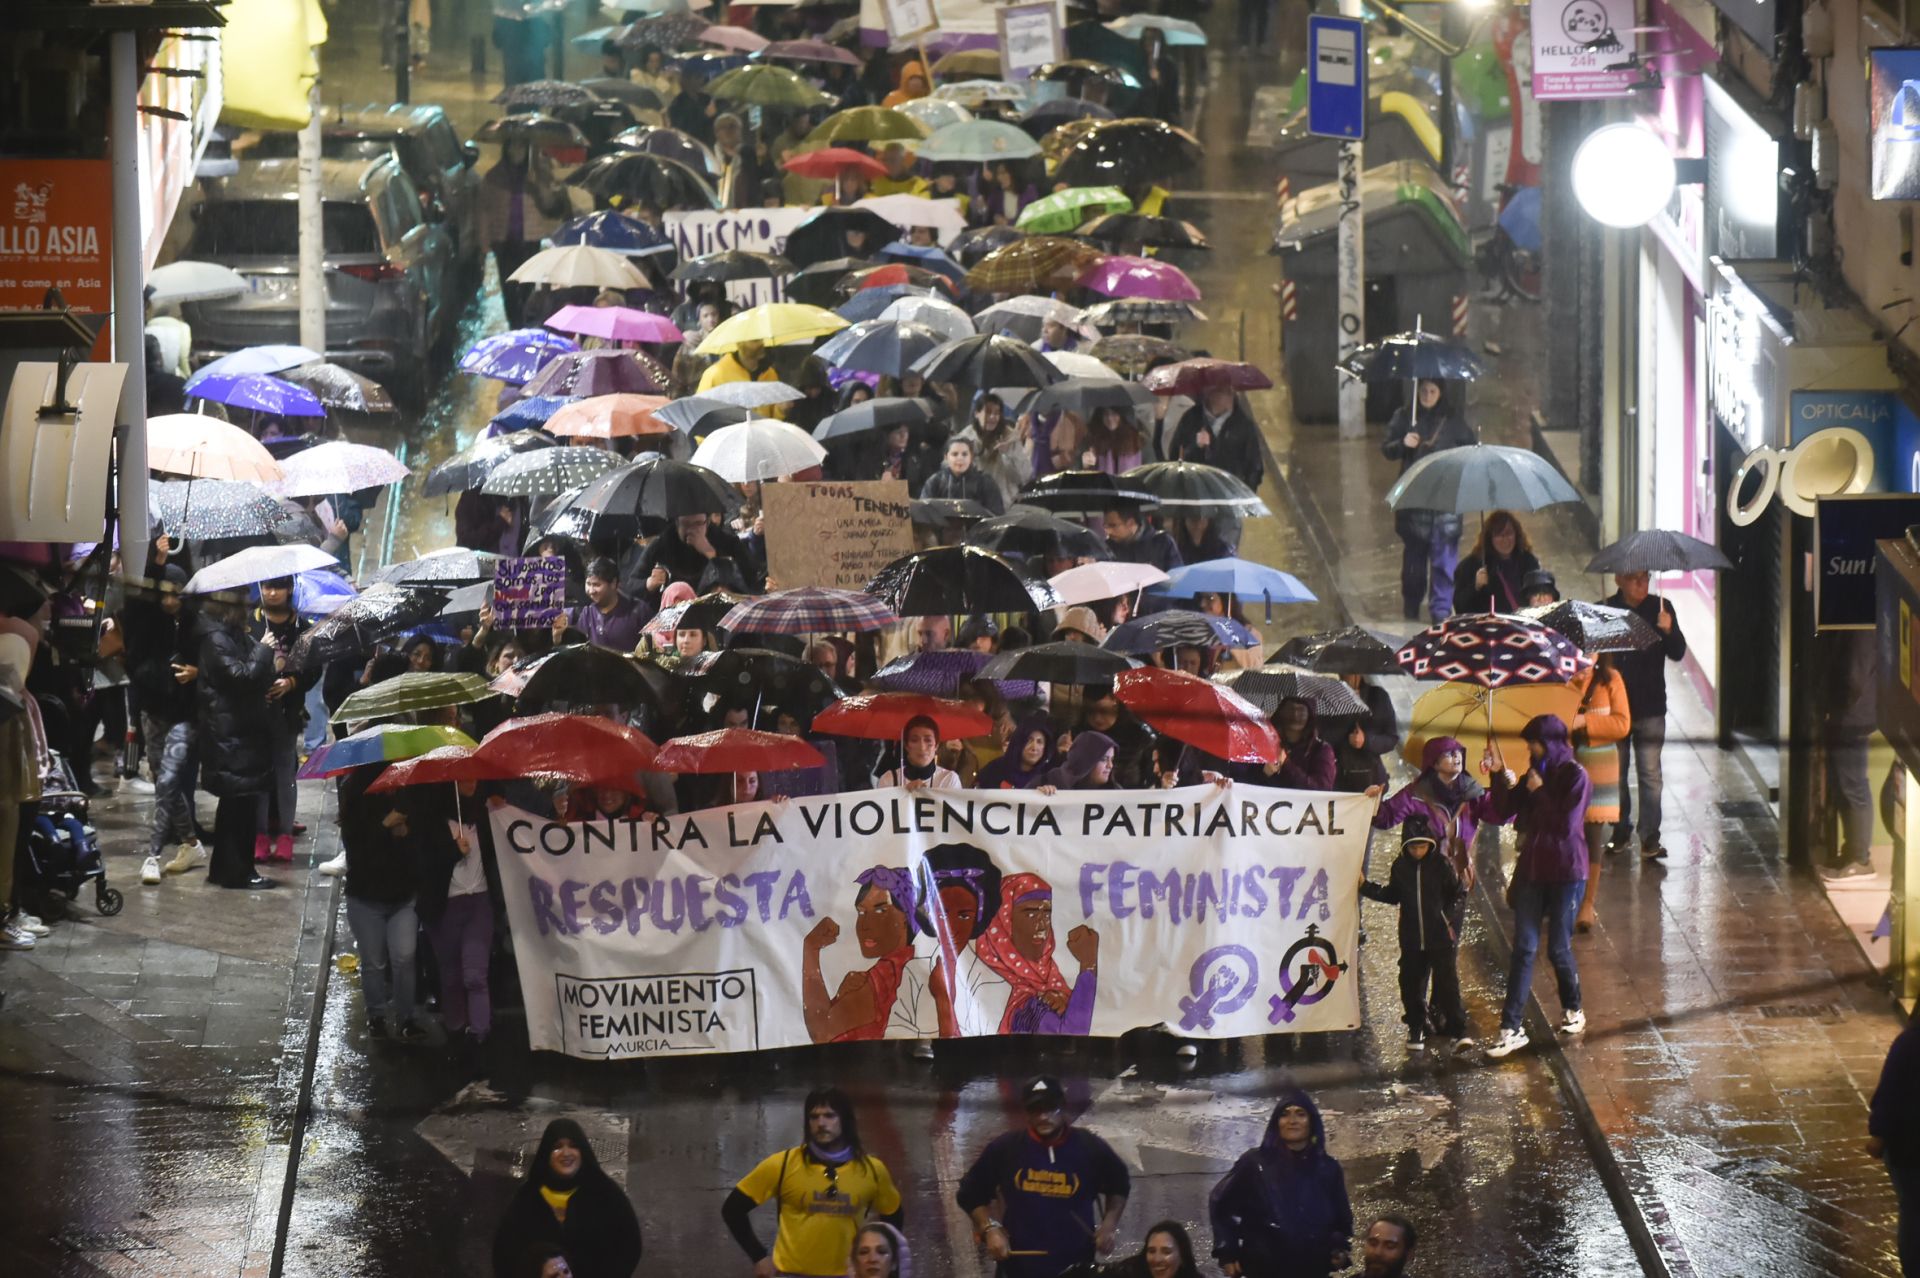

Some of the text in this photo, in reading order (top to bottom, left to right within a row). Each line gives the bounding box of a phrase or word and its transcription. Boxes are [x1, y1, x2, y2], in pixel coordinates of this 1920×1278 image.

[1541, 45, 1584, 56] HELLO
[1570, 54, 1596, 67] 24h
[0, 226, 99, 255] LLO ASIA
[22, 279, 52, 288] como
[56, 279, 71, 288] en
[77, 277, 102, 288] Asia
[853, 497, 911, 521] TENEMOS
[1827, 556, 1866, 576] Sun
[506, 797, 1345, 857] CONTRA LA VIOLENCIA PATRIARCAL
[528, 860, 1332, 937] RESPUESTA FEMINISTA
[564, 975, 746, 1009] MOVIMIENTO
[579, 1009, 727, 1040] FEMINISTA
[607, 1039, 671, 1055] MURCIA
